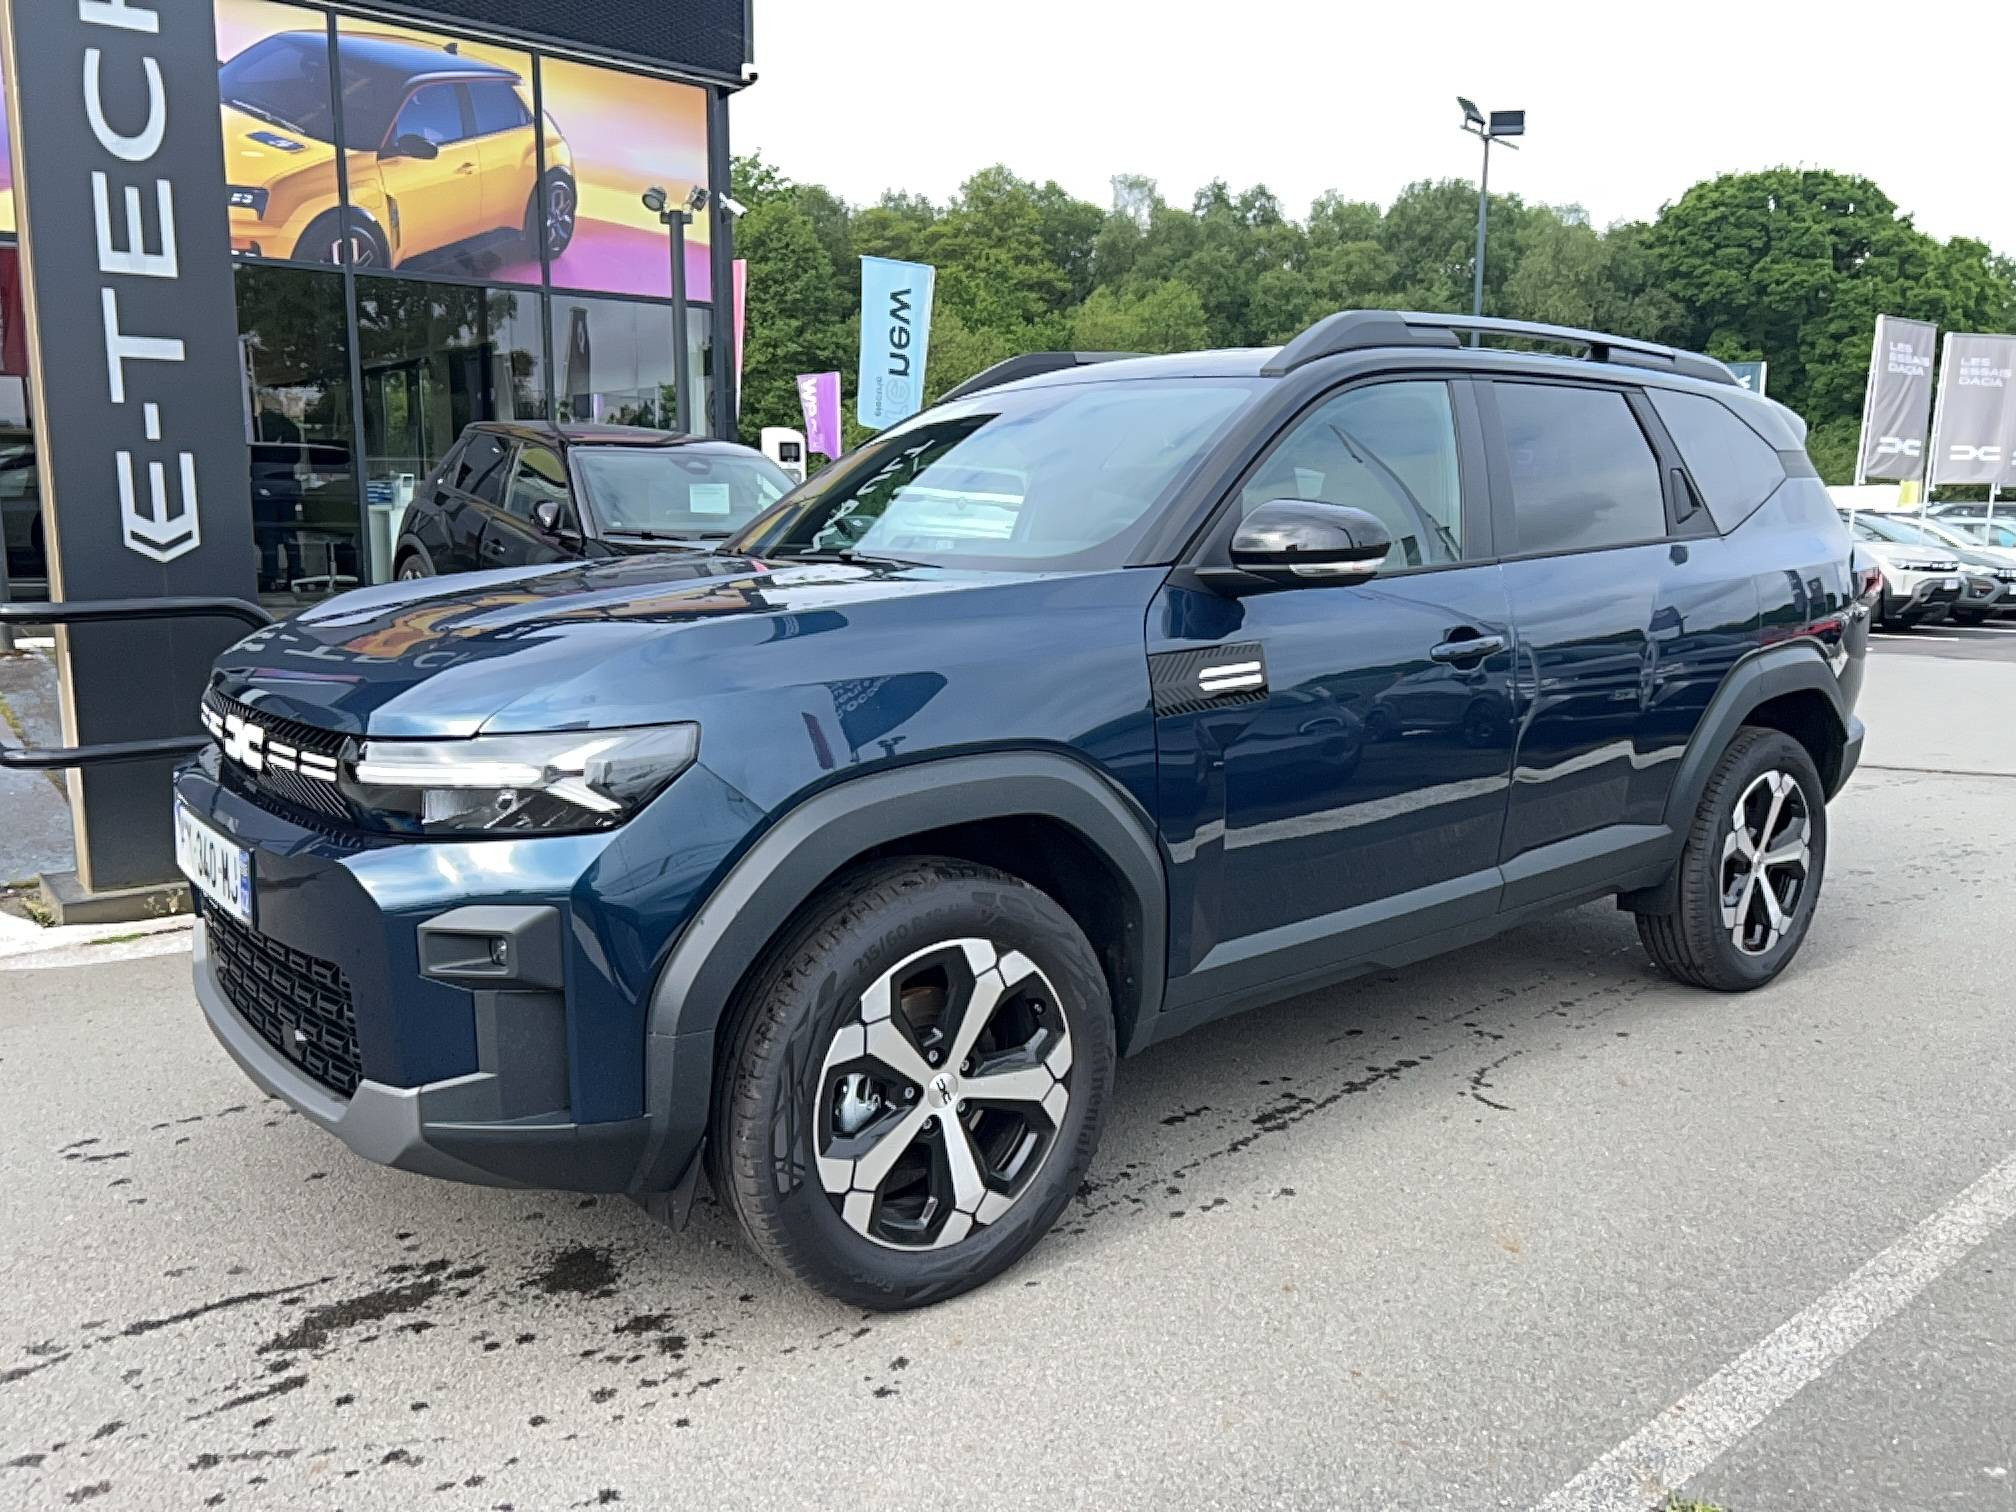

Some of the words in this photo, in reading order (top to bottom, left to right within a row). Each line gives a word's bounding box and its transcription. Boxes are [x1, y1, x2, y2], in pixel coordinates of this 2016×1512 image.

[1889, 341, 1913, 352] LES
[1961, 357, 1990, 366] LES
[1887, 362, 1924, 376] DACIA
[1959, 376, 2003, 387] DACIA
